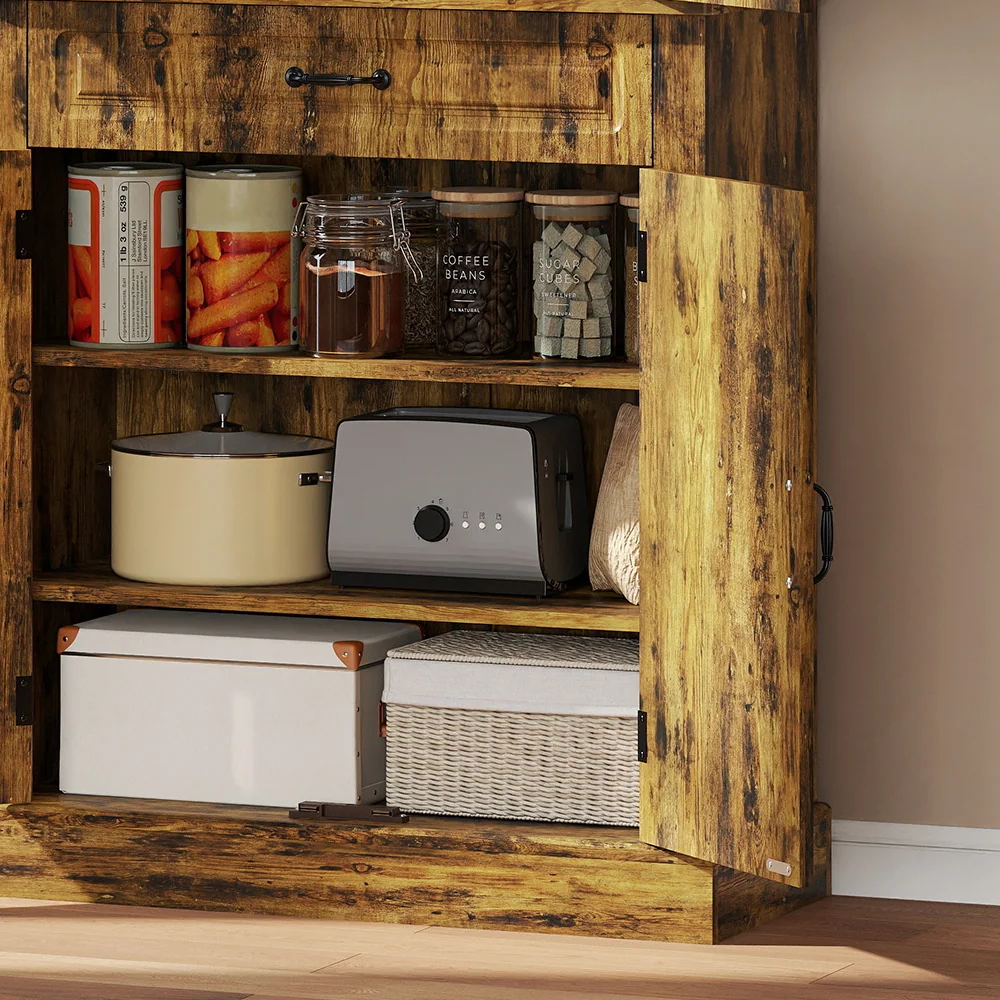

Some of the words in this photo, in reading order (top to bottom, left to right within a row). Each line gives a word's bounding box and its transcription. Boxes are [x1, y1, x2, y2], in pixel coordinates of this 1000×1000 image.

[120, 222, 126, 232] oz
[120, 246, 126, 255] lb
[442, 255, 489, 266] COFFEE
[540, 259, 580, 269] SUGAR
[445, 269, 486, 280] BEANS
[540, 273, 580, 284] CUBES
